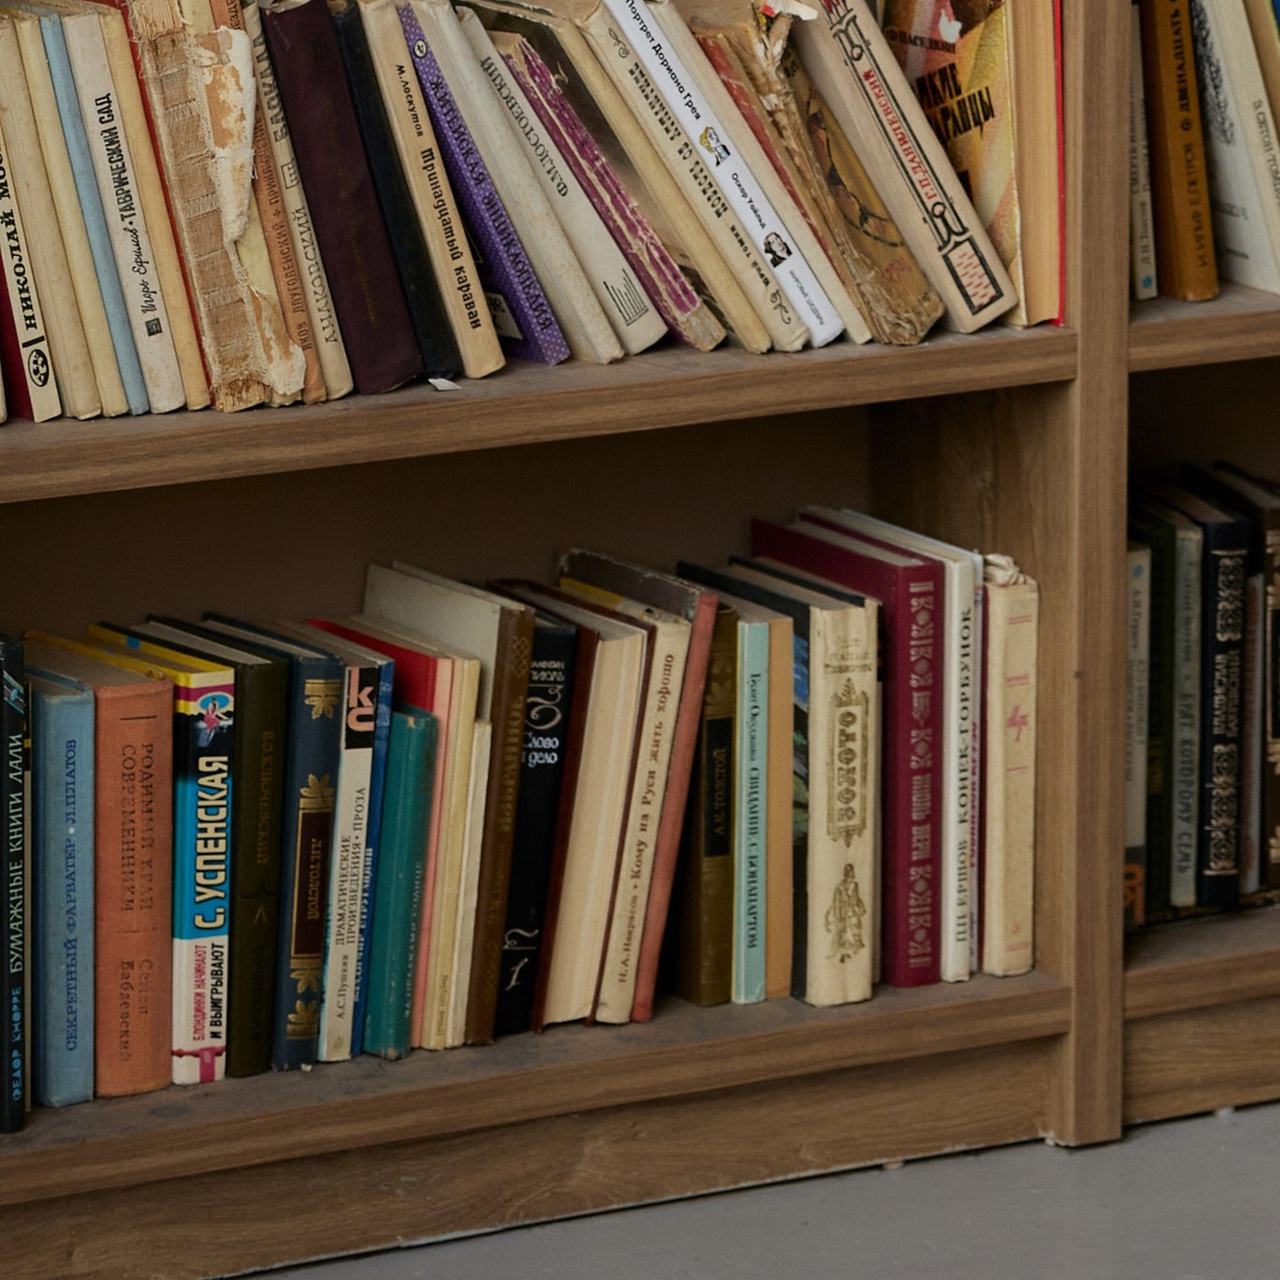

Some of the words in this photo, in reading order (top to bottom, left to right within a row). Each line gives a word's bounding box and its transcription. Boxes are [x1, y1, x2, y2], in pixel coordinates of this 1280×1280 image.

[648, 41, 687, 96] Дориана
[679, 91, 703, 122] Грея
[1167, 7, 1193, 113] ДВЕНАДЦАТЬ
[93, 91, 117, 124] САД
[98, 124, 137, 222] ТАВРИЧЕСКИЙ
[426, 74, 489, 187] ЖИТЕЙСКАЯ
[479, 191, 555, 334] ЭНЦИКЛОПЕДИЯ
[726, 170, 752, 202] Оскар
[742, 196, 770, 230] Уайльд
[0, 207, 39, 332] НИКОЛАЙ
[133, 276, 161, 314] Игорь
[450, 264, 482, 331] караван
[655, 652, 678, 714] хорошо
[955, 606, 974, 824] КОНЕК-ГОРБУНОК
[1177, 692, 1193, 732] БРАТ
[7, 732, 24, 783] ЛАЛИ
[648, 720, 665, 762] жить
[135, 743, 156, 850] РОДИМЫЙ
[351, 786, 366, 832] ПРОЗА
[640, 768, 660, 807] Руси
[746, 765, 760, 837] СВИДАНИЕ
[1176, 737, 1193, 825] КОТОРОМУ
[7, 791, 24, 853] КНИГИ
[115, 743, 137, 912] СОВРЕМЕННИКИ
[192, 753, 231, 904] УСПЕНСКАЯ
[638, 812, 651, 833] на
[746, 841, 759, 851] С
[1176, 831, 1192, 874] СЕМЬ
[63, 836, 78, 933] ФАРВАТЕР
[332, 833, 353, 946] ДРАМАТИЧЕСКИЕ
[629, 838, 650, 881] Кому
[955, 839, 970, 907] ЕРШОВ
[6, 858, 26, 974] БУМАЖНЫЕ
[194, 905, 226, 930] С.
[343, 840, 363, 945] ПРОИЗВЕДЕНИЯ
[745, 853, 759, 950] БОНАПАРТОМ
[62, 936, 78, 1052] СЕКРЕТНЫЙ
[193, 943, 208, 990] НАЧИНАЮТ
[207, 941, 226, 1027] ВЫИГРЫВАЮТ
[9, 985, 23, 1042] КНОРРЕ
[191, 989, 207, 1041] БЛОНДИНКИ
[208, 1030, 222, 1039] И
[9, 1048, 24, 1101] ФЕДОР
